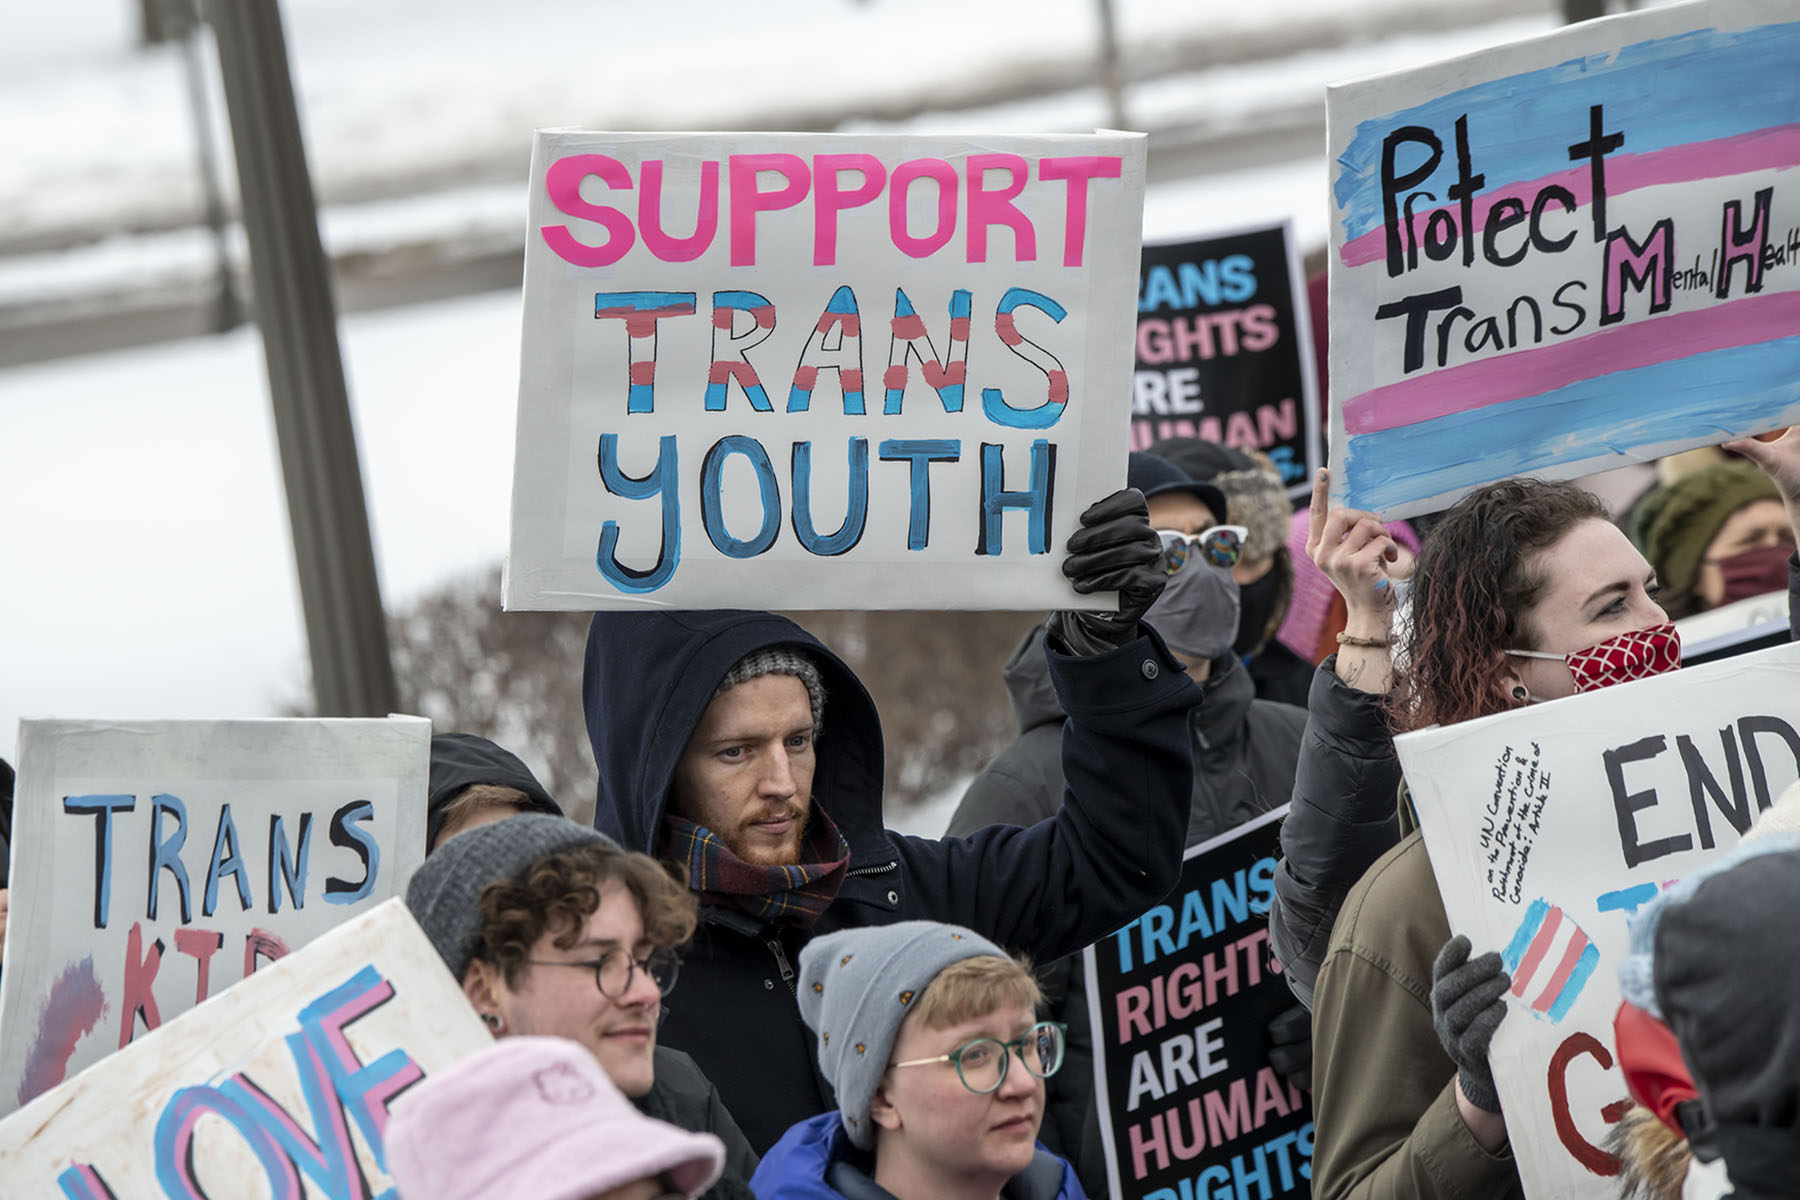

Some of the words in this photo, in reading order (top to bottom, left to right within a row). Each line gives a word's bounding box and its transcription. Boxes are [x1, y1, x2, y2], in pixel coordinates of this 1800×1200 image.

[541, 153, 1122, 267] SUPPORT
[1382, 105, 1624, 277] Protect
[1138, 254, 1258, 313] ANS
[1376, 285, 1587, 374] Trans
[1600, 217, 1718, 326] Mental
[1716, 186, 1800, 299] Healt
[595, 285, 1069, 429] TRANS
[1136, 304, 1280, 365] GHTS
[1132, 367, 1204, 415] RE
[597, 433, 1058, 594] YOUTH
[1486, 746, 1514, 815] Convention
[1524, 759, 1539, 798] Crime
[1531, 742, 1541, 757] of
[1540, 771, 1551, 790] II
[1495, 770, 1523, 847] Prevention
[1517, 801, 1531, 821] the
[1603, 715, 1800, 869] END
[63, 793, 381, 929] TRANS
[1480, 816, 1495, 848] UN
[1488, 849, 1500, 864] the
[1513, 823, 1521, 841] of
[1487, 869, 1494, 883] on
[1106, 857, 1279, 974] TRANS
[1115, 927, 1283, 1045] RIGHT
[1127, 1017, 1229, 1112] ARE
[1128, 1066, 1312, 1180] HUMA
[1142, 1121, 1315, 1200] GHTS
